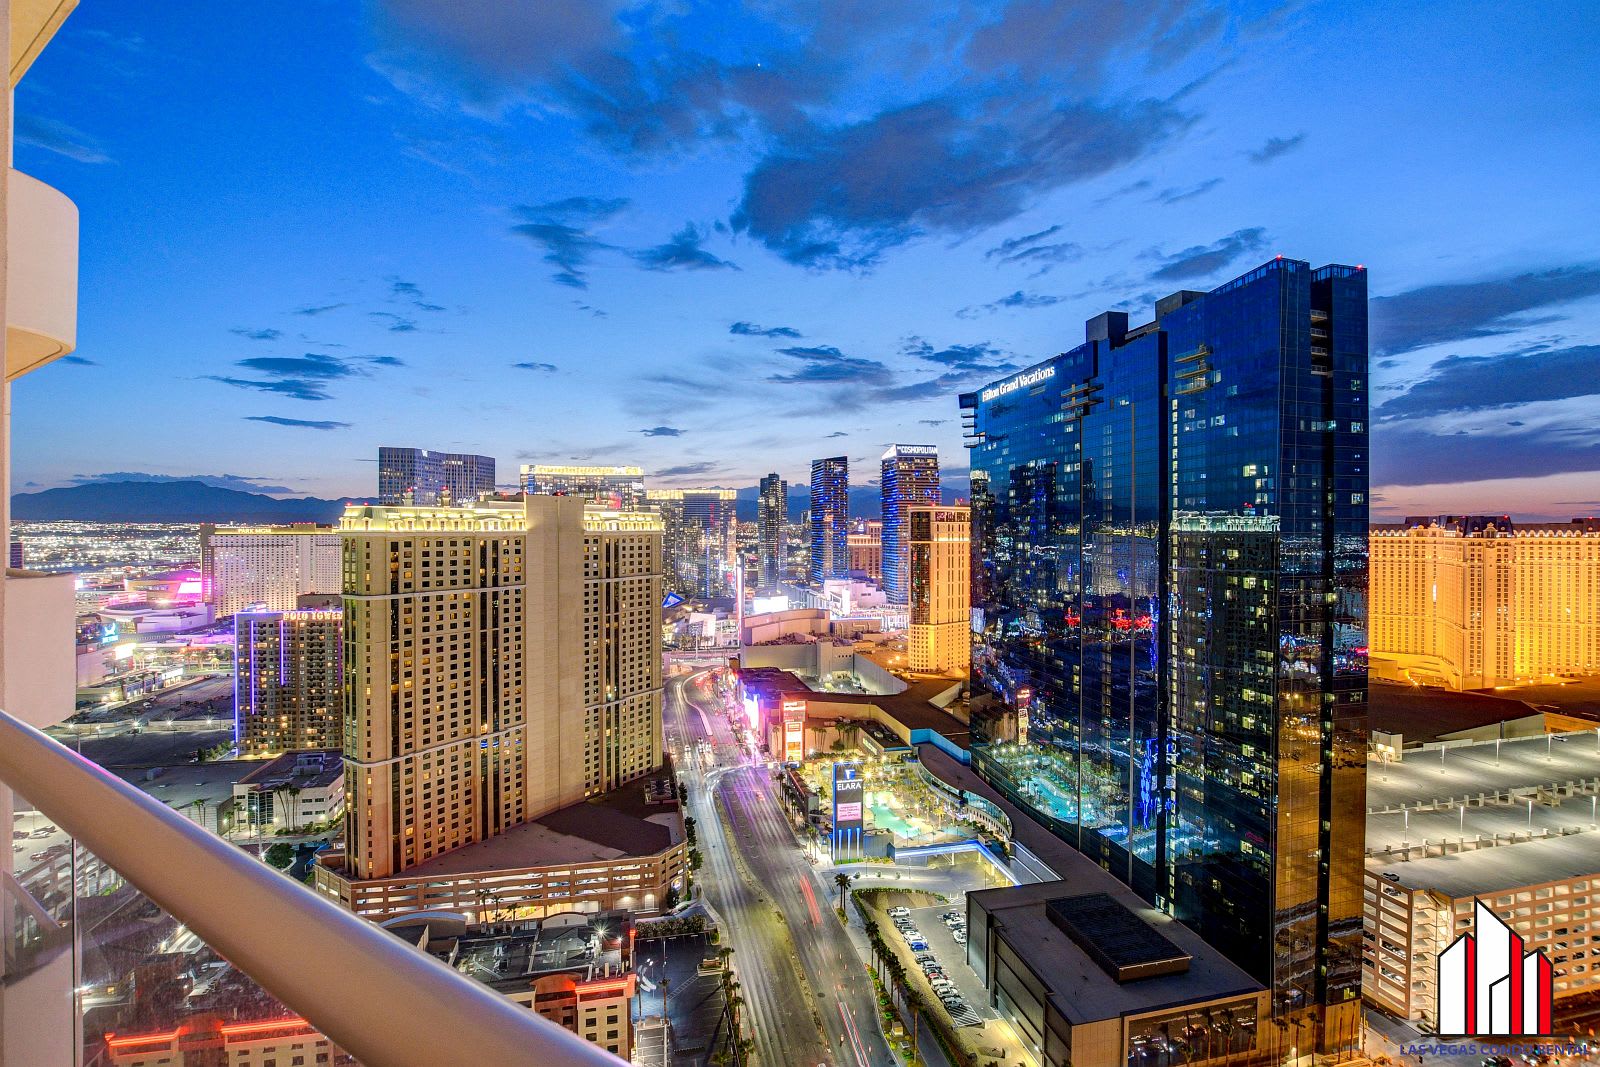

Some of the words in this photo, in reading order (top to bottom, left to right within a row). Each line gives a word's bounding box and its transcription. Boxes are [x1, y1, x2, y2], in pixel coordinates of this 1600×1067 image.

[982, 387, 1000, 402] Hilton
[1000, 377, 1018, 395] Grand
[1019, 366, 1055, 387] Vacations
[901, 446, 938, 454] COSMOPOLITAN
[283, 612, 308, 620] POLO
[837, 782, 862, 791] ELARA
